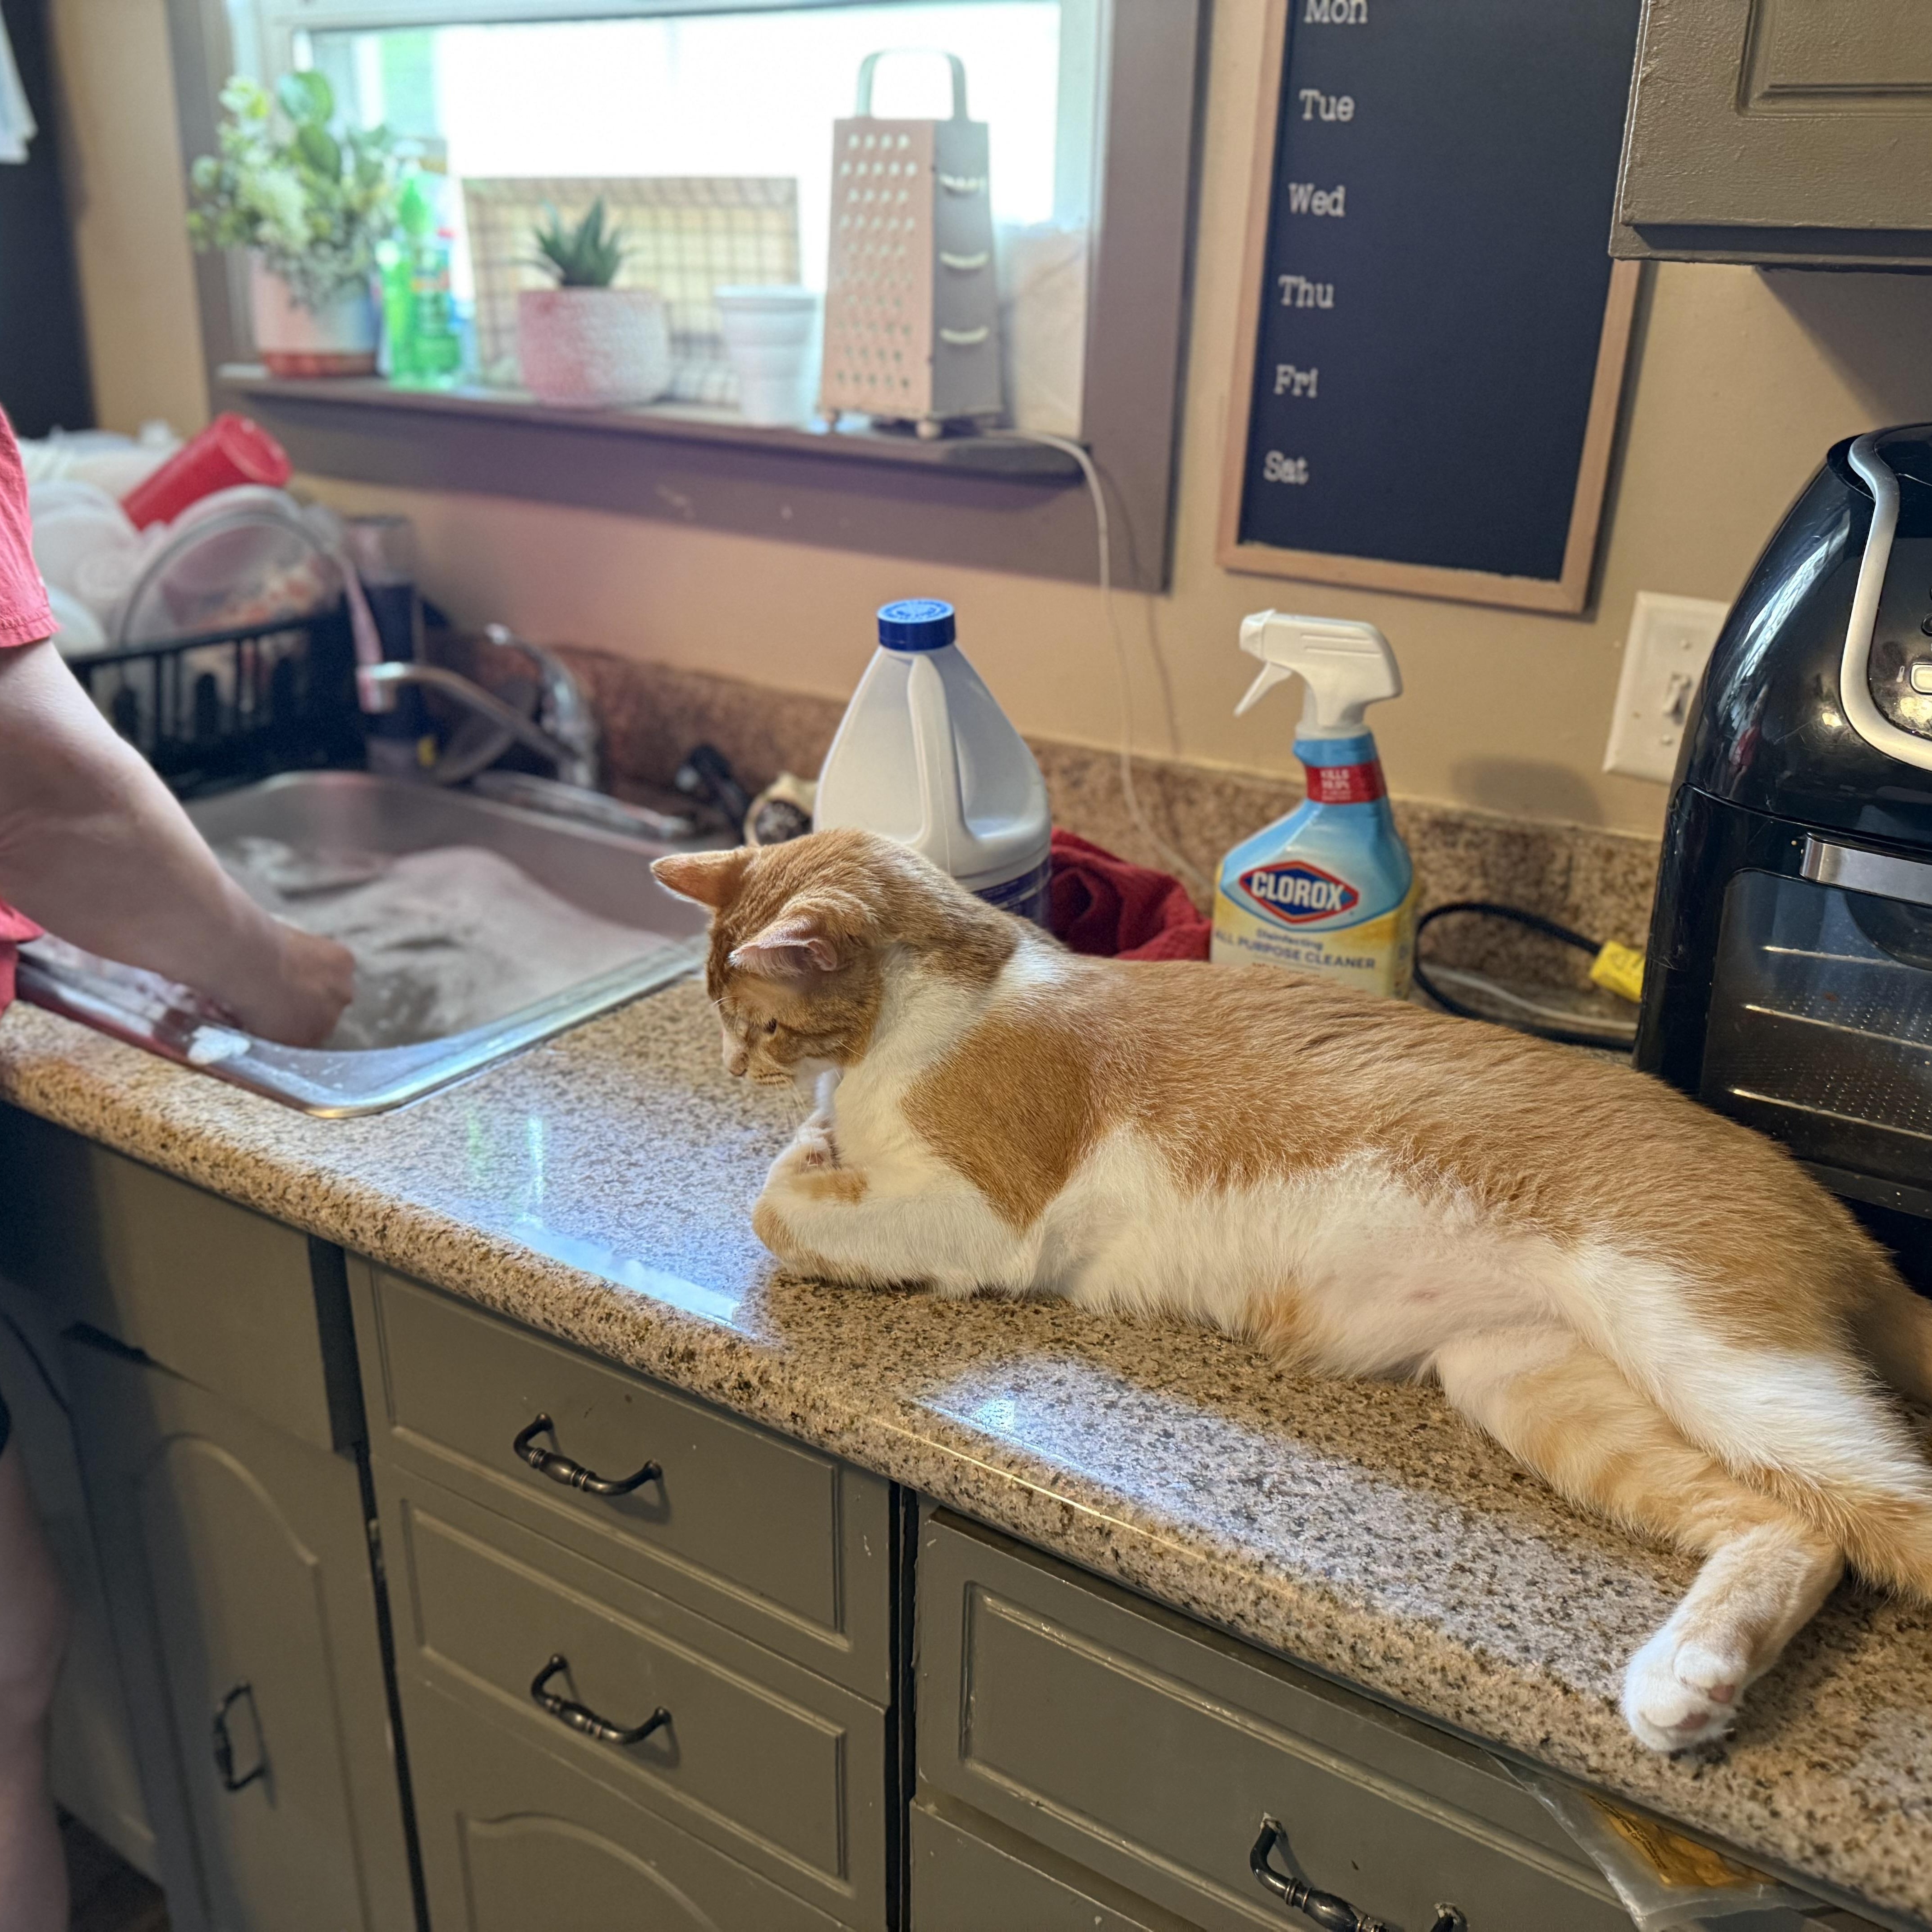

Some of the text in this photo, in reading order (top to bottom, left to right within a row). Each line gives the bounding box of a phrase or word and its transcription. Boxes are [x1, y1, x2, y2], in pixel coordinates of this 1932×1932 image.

[1304, 0, 1368, 24] Mon
[1299, 89, 1355, 122] Tue
[1288, 183, 1346, 217] Wed
[1278, 274, 1334, 308] Thu
[1273, 364, 1318, 398] Fri
[1263, 450, 1309, 485] Sat
[1251, 871, 1344, 911] CLOROX
[1237, 936, 1300, 961] PURPOSE
[1304, 952, 1375, 969] CLEANER
[1256, 928, 1324, 951] Disinfecting
